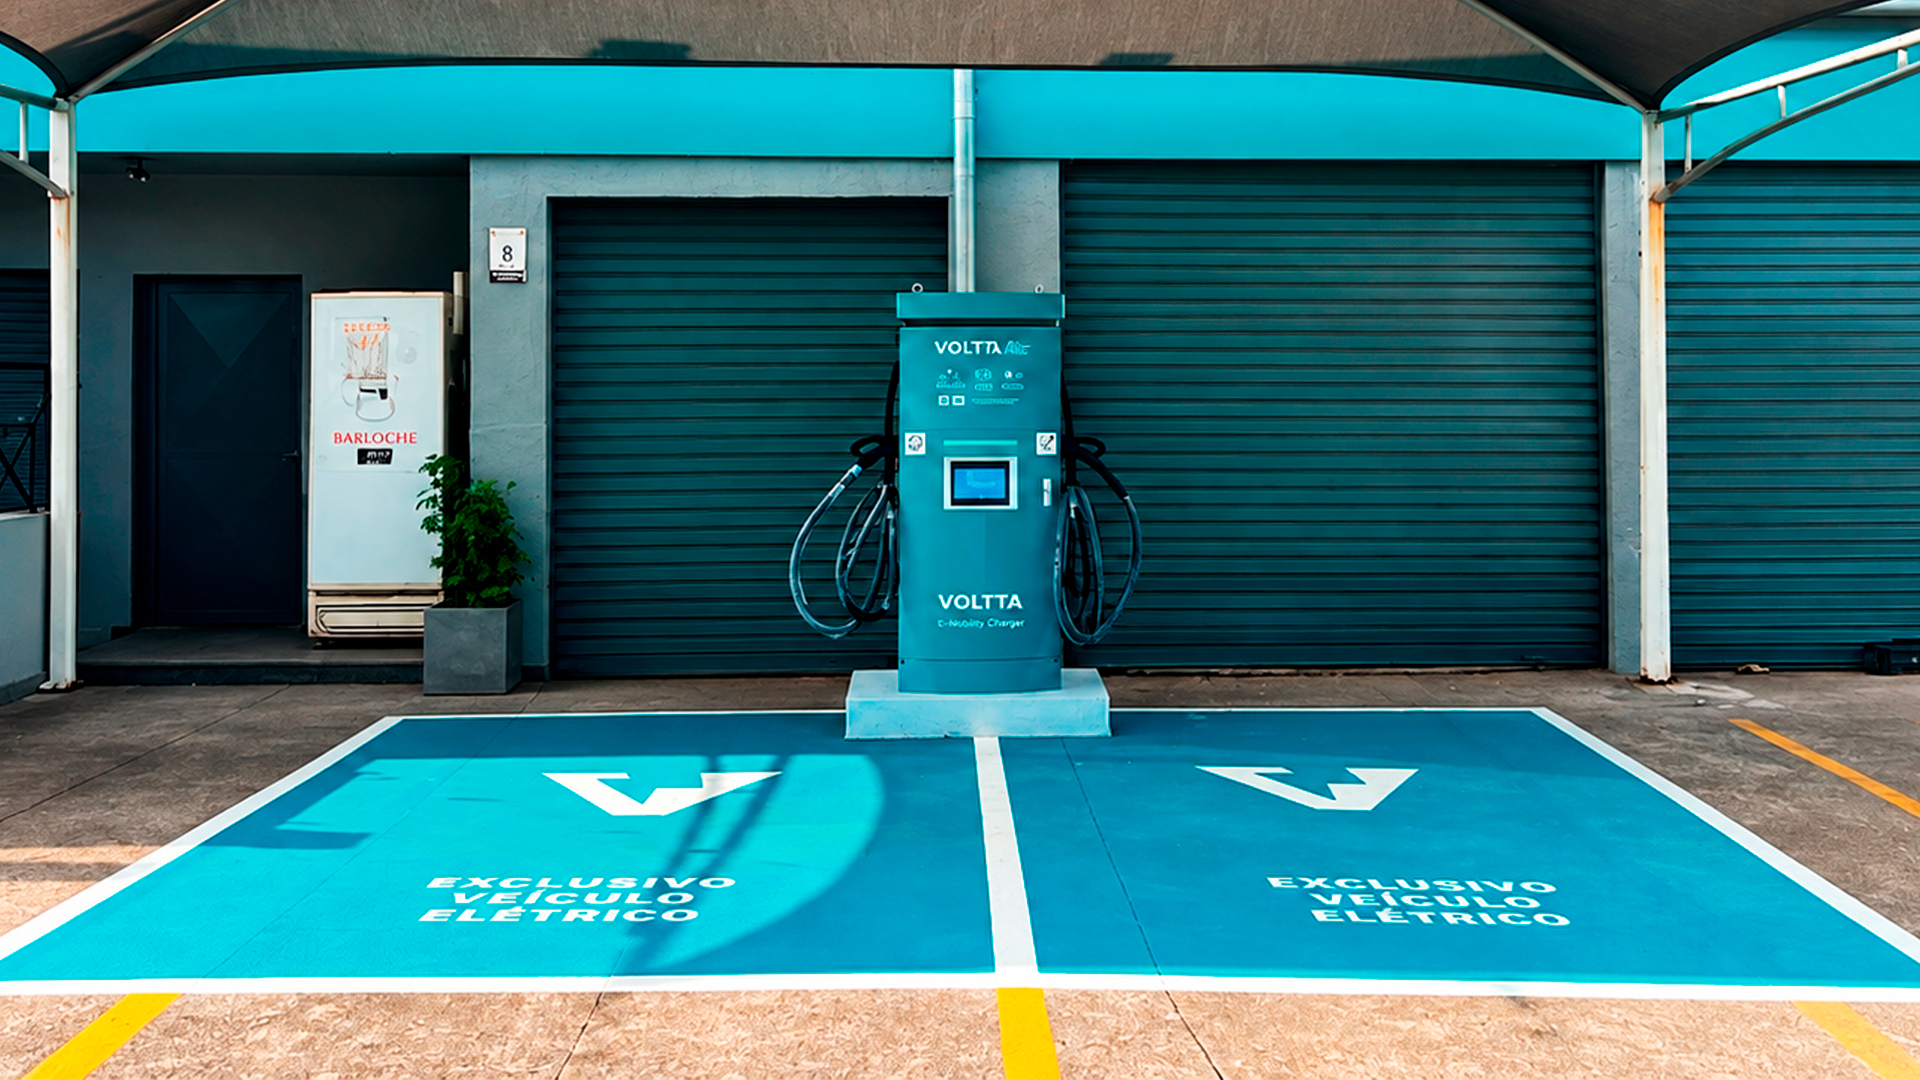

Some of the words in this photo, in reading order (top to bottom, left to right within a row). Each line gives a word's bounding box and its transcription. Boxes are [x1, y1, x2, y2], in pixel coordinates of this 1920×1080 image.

[502, 244, 513, 262] 8
[934, 341, 1002, 354] VOLTTA
[333, 432, 417, 444] BARLOCHE
[938, 594, 1023, 610] VOLTTA
[987, 617, 1025, 629] Charger
[427, 877, 736, 889] EXCLUSIVO
[1266, 877, 1557, 893] EXCLUSIVO
[453, 889, 694, 904] VEÍCULO
[1310, 891, 1541, 908] VEÍCULO
[419, 906, 699, 921] ELÉTRICO
[1311, 908, 1571, 926] ELÉTRICO
